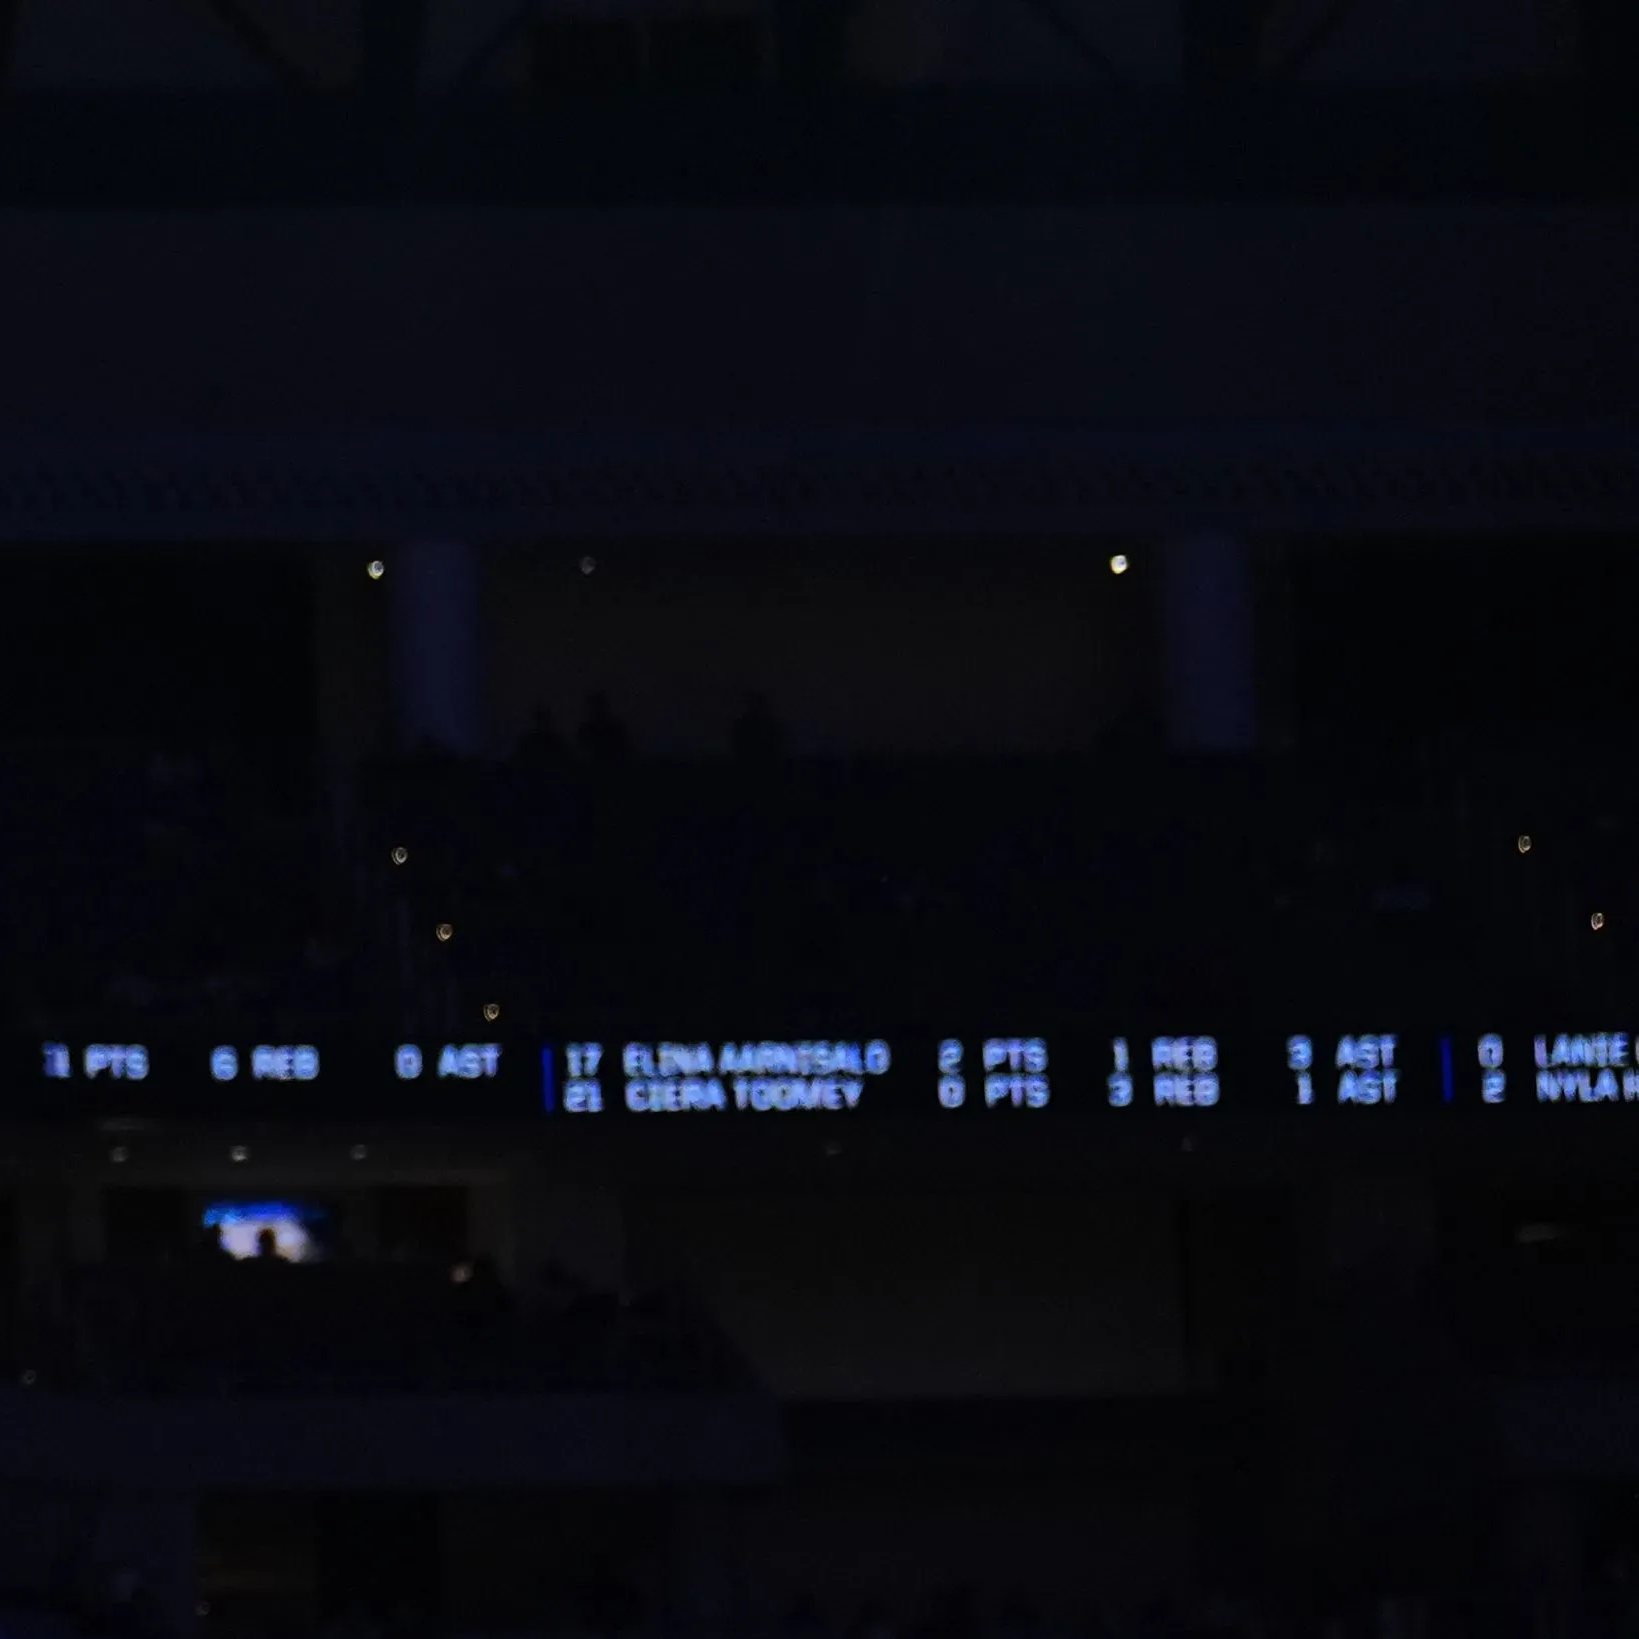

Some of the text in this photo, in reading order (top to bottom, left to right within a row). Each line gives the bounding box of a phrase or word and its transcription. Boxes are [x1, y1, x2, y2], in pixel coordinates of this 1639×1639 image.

[83, 1043, 151, 1081] PTS
[251, 1043, 321, 1081] REB
[436, 1042, 503, 1080] AST
[563, 1041, 603, 1076] 17
[937, 1037, 963, 1073] 2
[981, 1037, 1049, 1073] PTS
[1151, 1034, 1218, 1073] REB
[1334, 1034, 1399, 1071] AST
[1475, 1032, 1504, 1068] 0
[982, 1071, 1050, 1109] PTS
[1152, 1070, 1220, 1107] REB
[1336, 1069, 1400, 1106] AST
